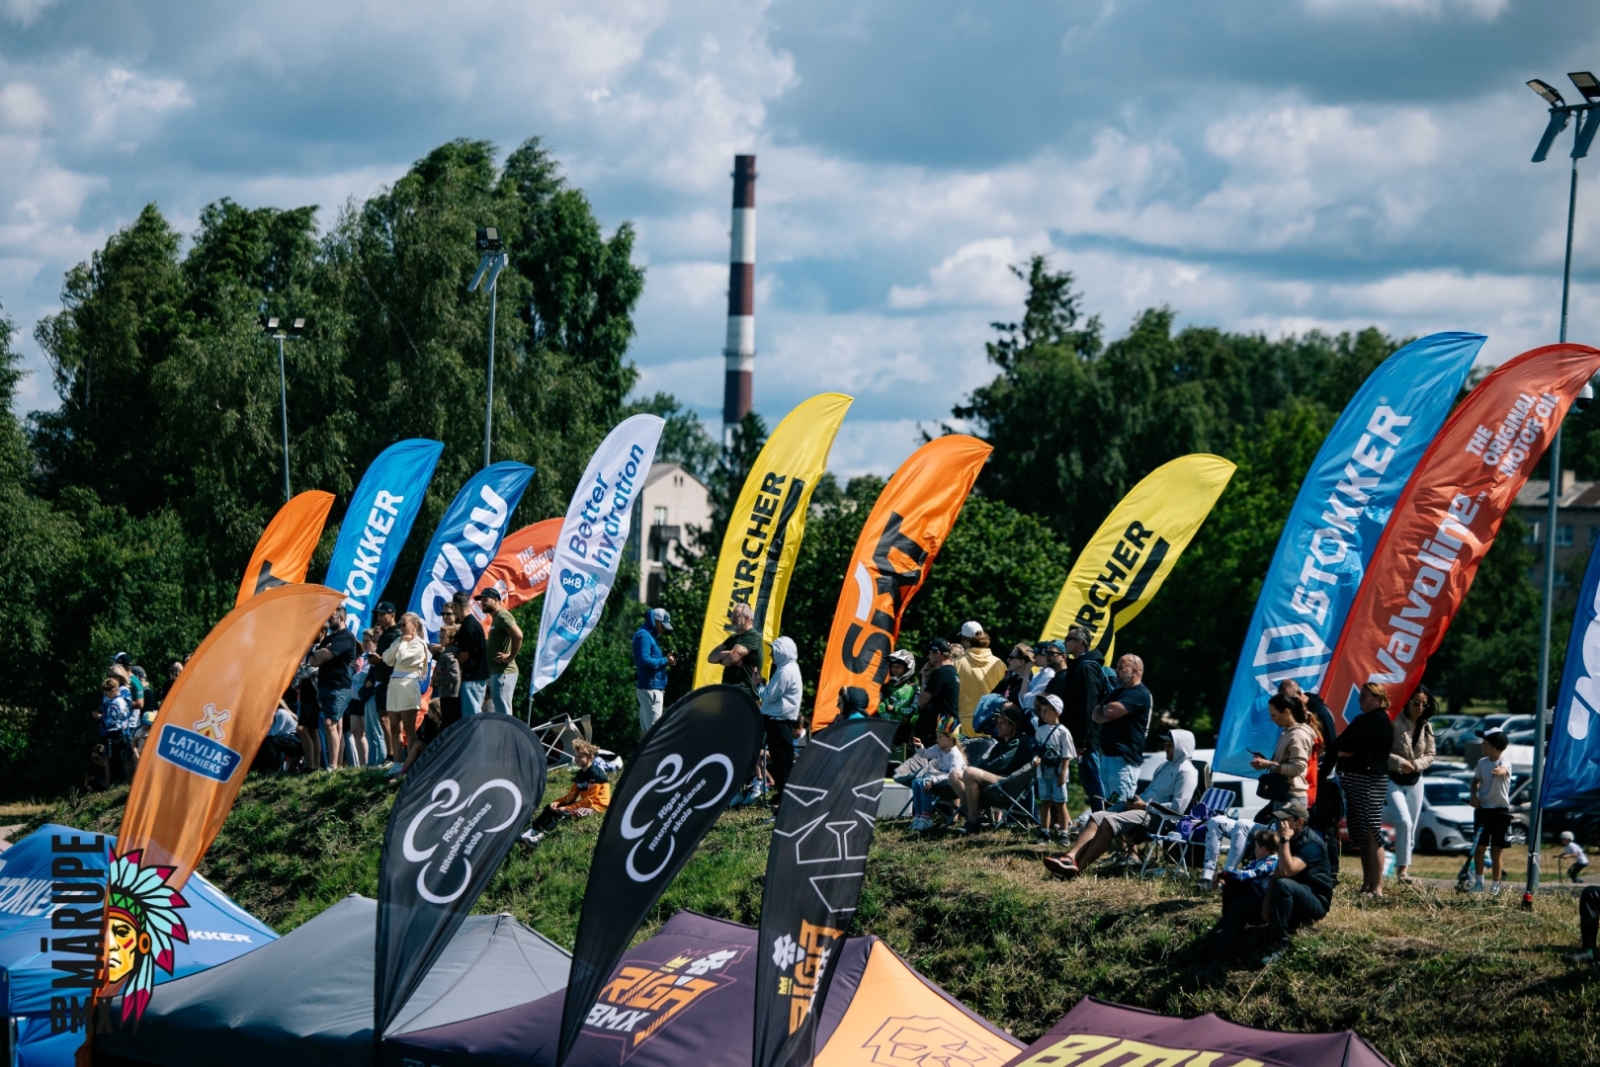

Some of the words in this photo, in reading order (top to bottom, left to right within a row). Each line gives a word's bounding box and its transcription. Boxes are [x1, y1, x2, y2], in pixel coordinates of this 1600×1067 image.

[1465, 424, 1494, 457] THE
[1483, 393, 1537, 466] ORIGINAL
[1498, 415, 1545, 478] MOTOR
[1535, 392, 1561, 418] OIL
[568, 471, 609, 560] Better
[592, 443, 645, 569] hydration
[1290, 404, 1412, 626] STOKKER
[516, 545, 537, 565] THE
[523, 546, 557, 576] ORIGIN
[1073, 520, 1155, 635] RCHER
[1367, 492, 1480, 684] Valvoline
[168, 732, 232, 767] LATVIJAS
[169, 746, 222, 775] MAIZNIEKS
[648, 778, 707, 851] Riteņbraukšanas
[657, 791, 681, 819] Rīgas
[672, 807, 693, 833] skola
[439, 802, 492, 874] Riteņbraukšanas
[442, 815, 465, 843] Rīgas
[463, 831, 483, 856] skola
[187, 929, 253, 943] KKER
[585, 1002, 651, 1032] BMX
